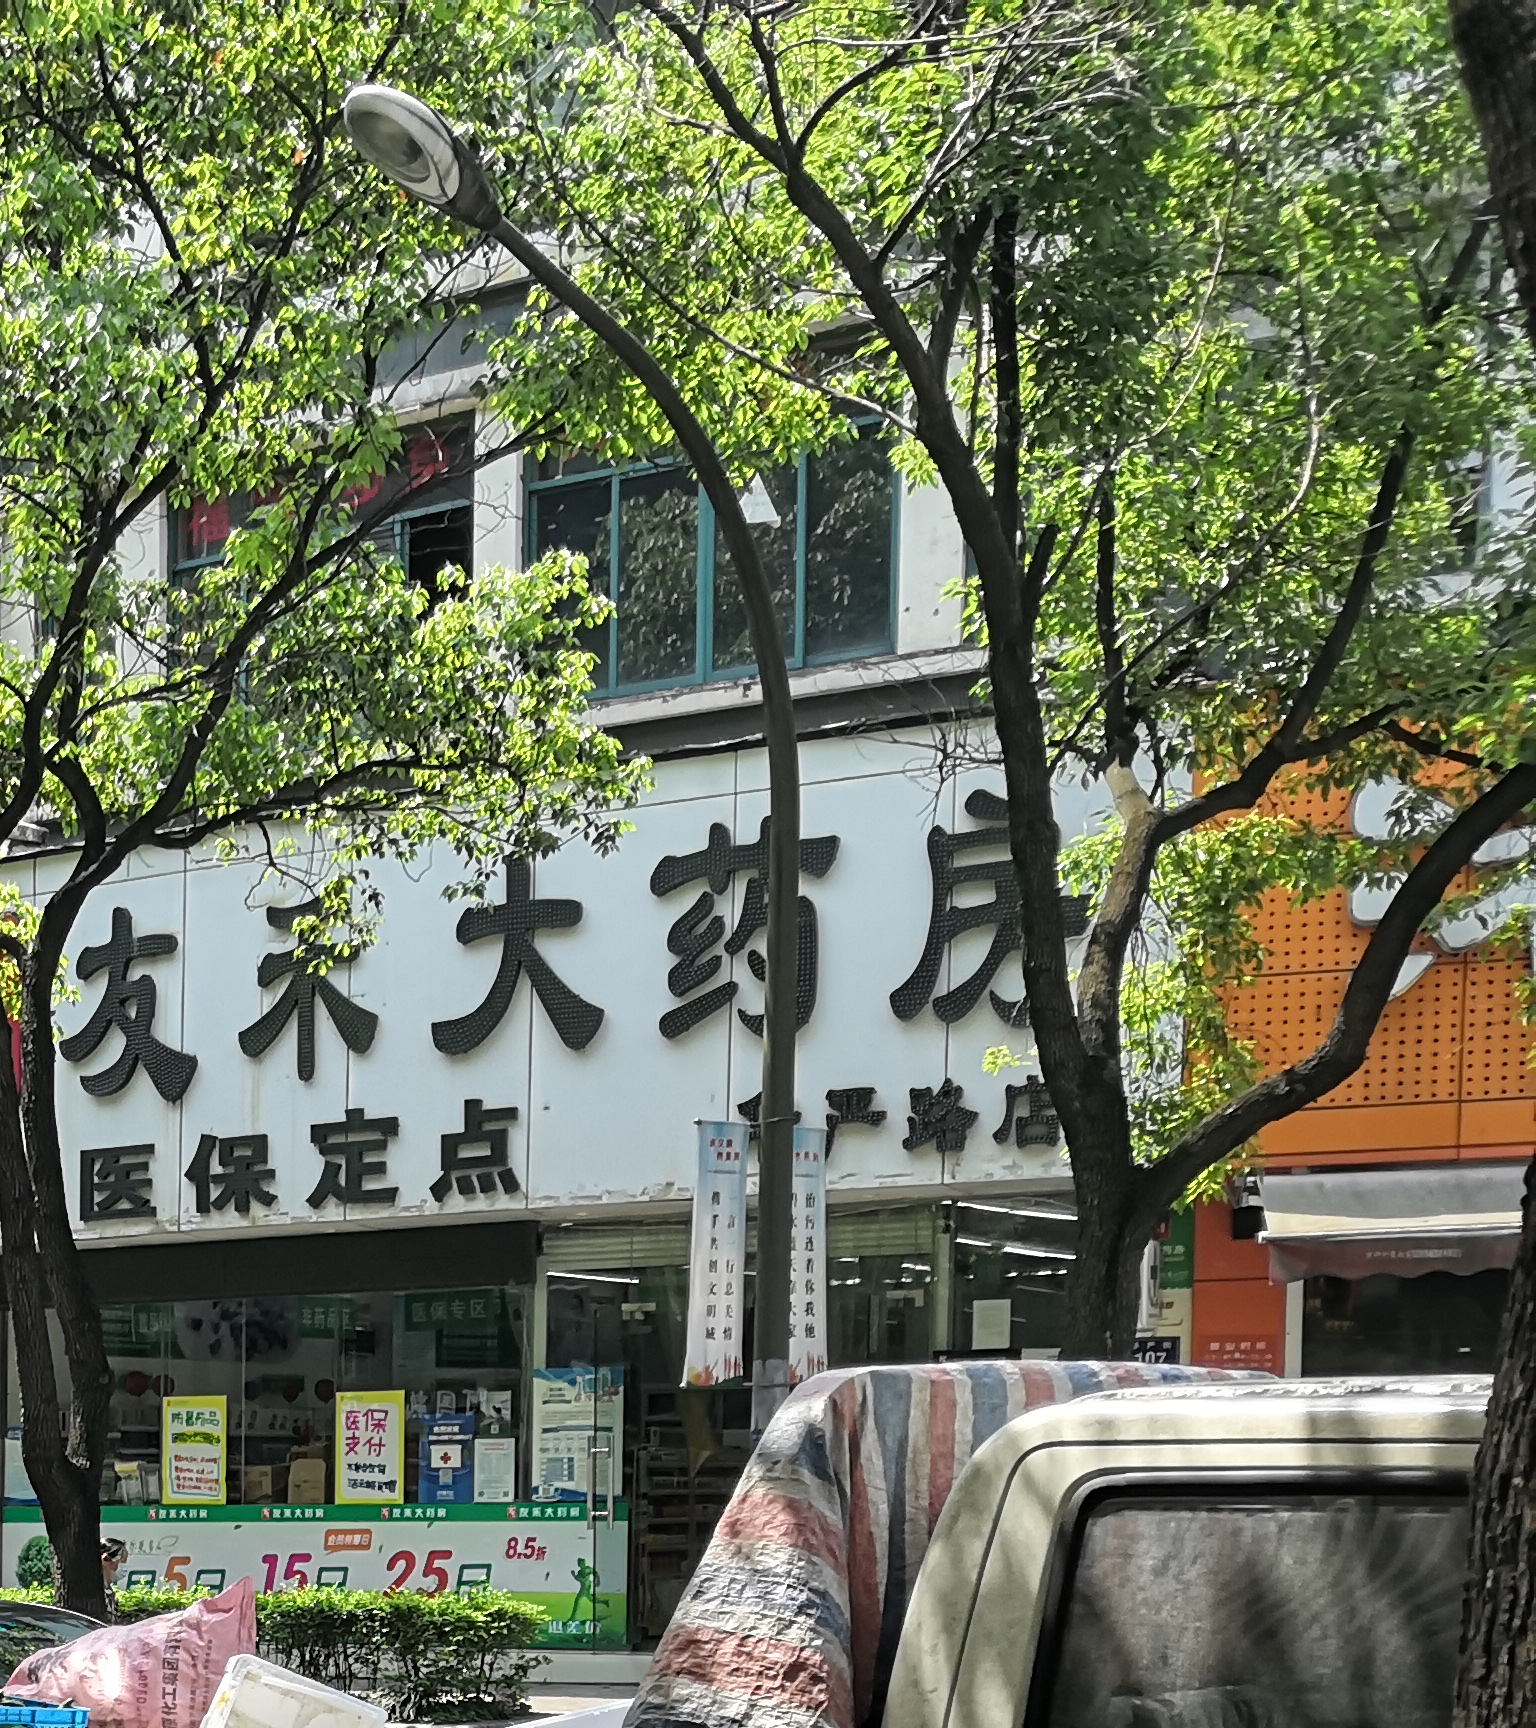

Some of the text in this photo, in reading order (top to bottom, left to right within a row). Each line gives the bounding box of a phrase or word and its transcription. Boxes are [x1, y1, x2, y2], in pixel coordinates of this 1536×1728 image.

[79, 1098, 520, 1222] 医保定点
[344, 1408, 389, 1433] 医保
[344, 1431, 387, 1457] 支付
